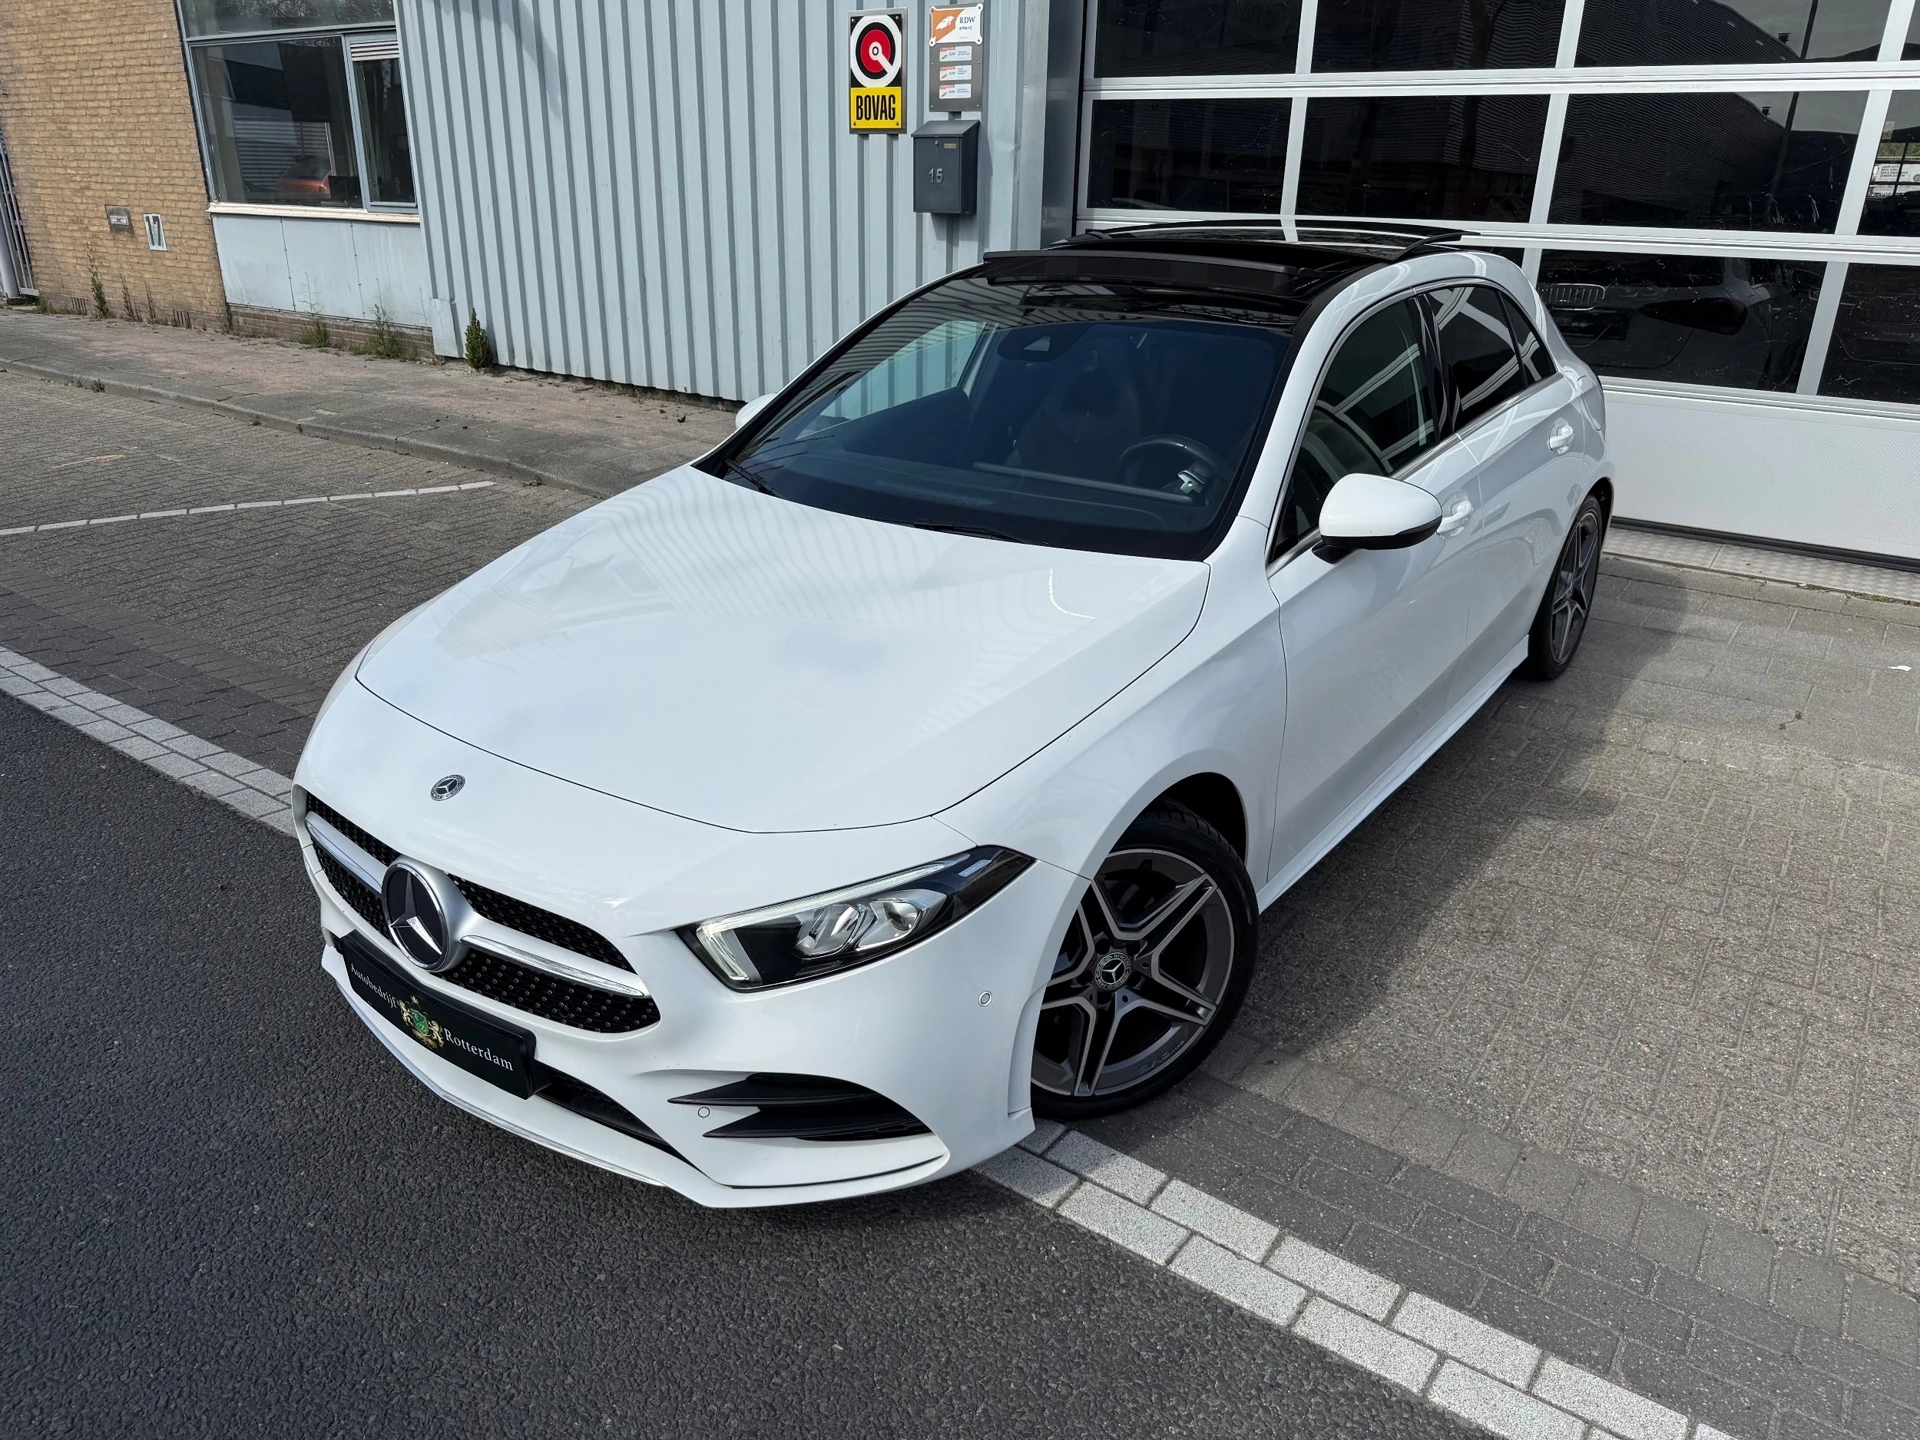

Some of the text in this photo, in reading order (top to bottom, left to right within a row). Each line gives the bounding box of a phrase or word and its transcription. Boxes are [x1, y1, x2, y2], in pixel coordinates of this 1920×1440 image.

[959, 16, 976, 24] RDW
[856, 93, 896, 121] BOVAG
[928, 168, 943, 184] 15
[443, 1027, 514, 1071] Rotterdam
